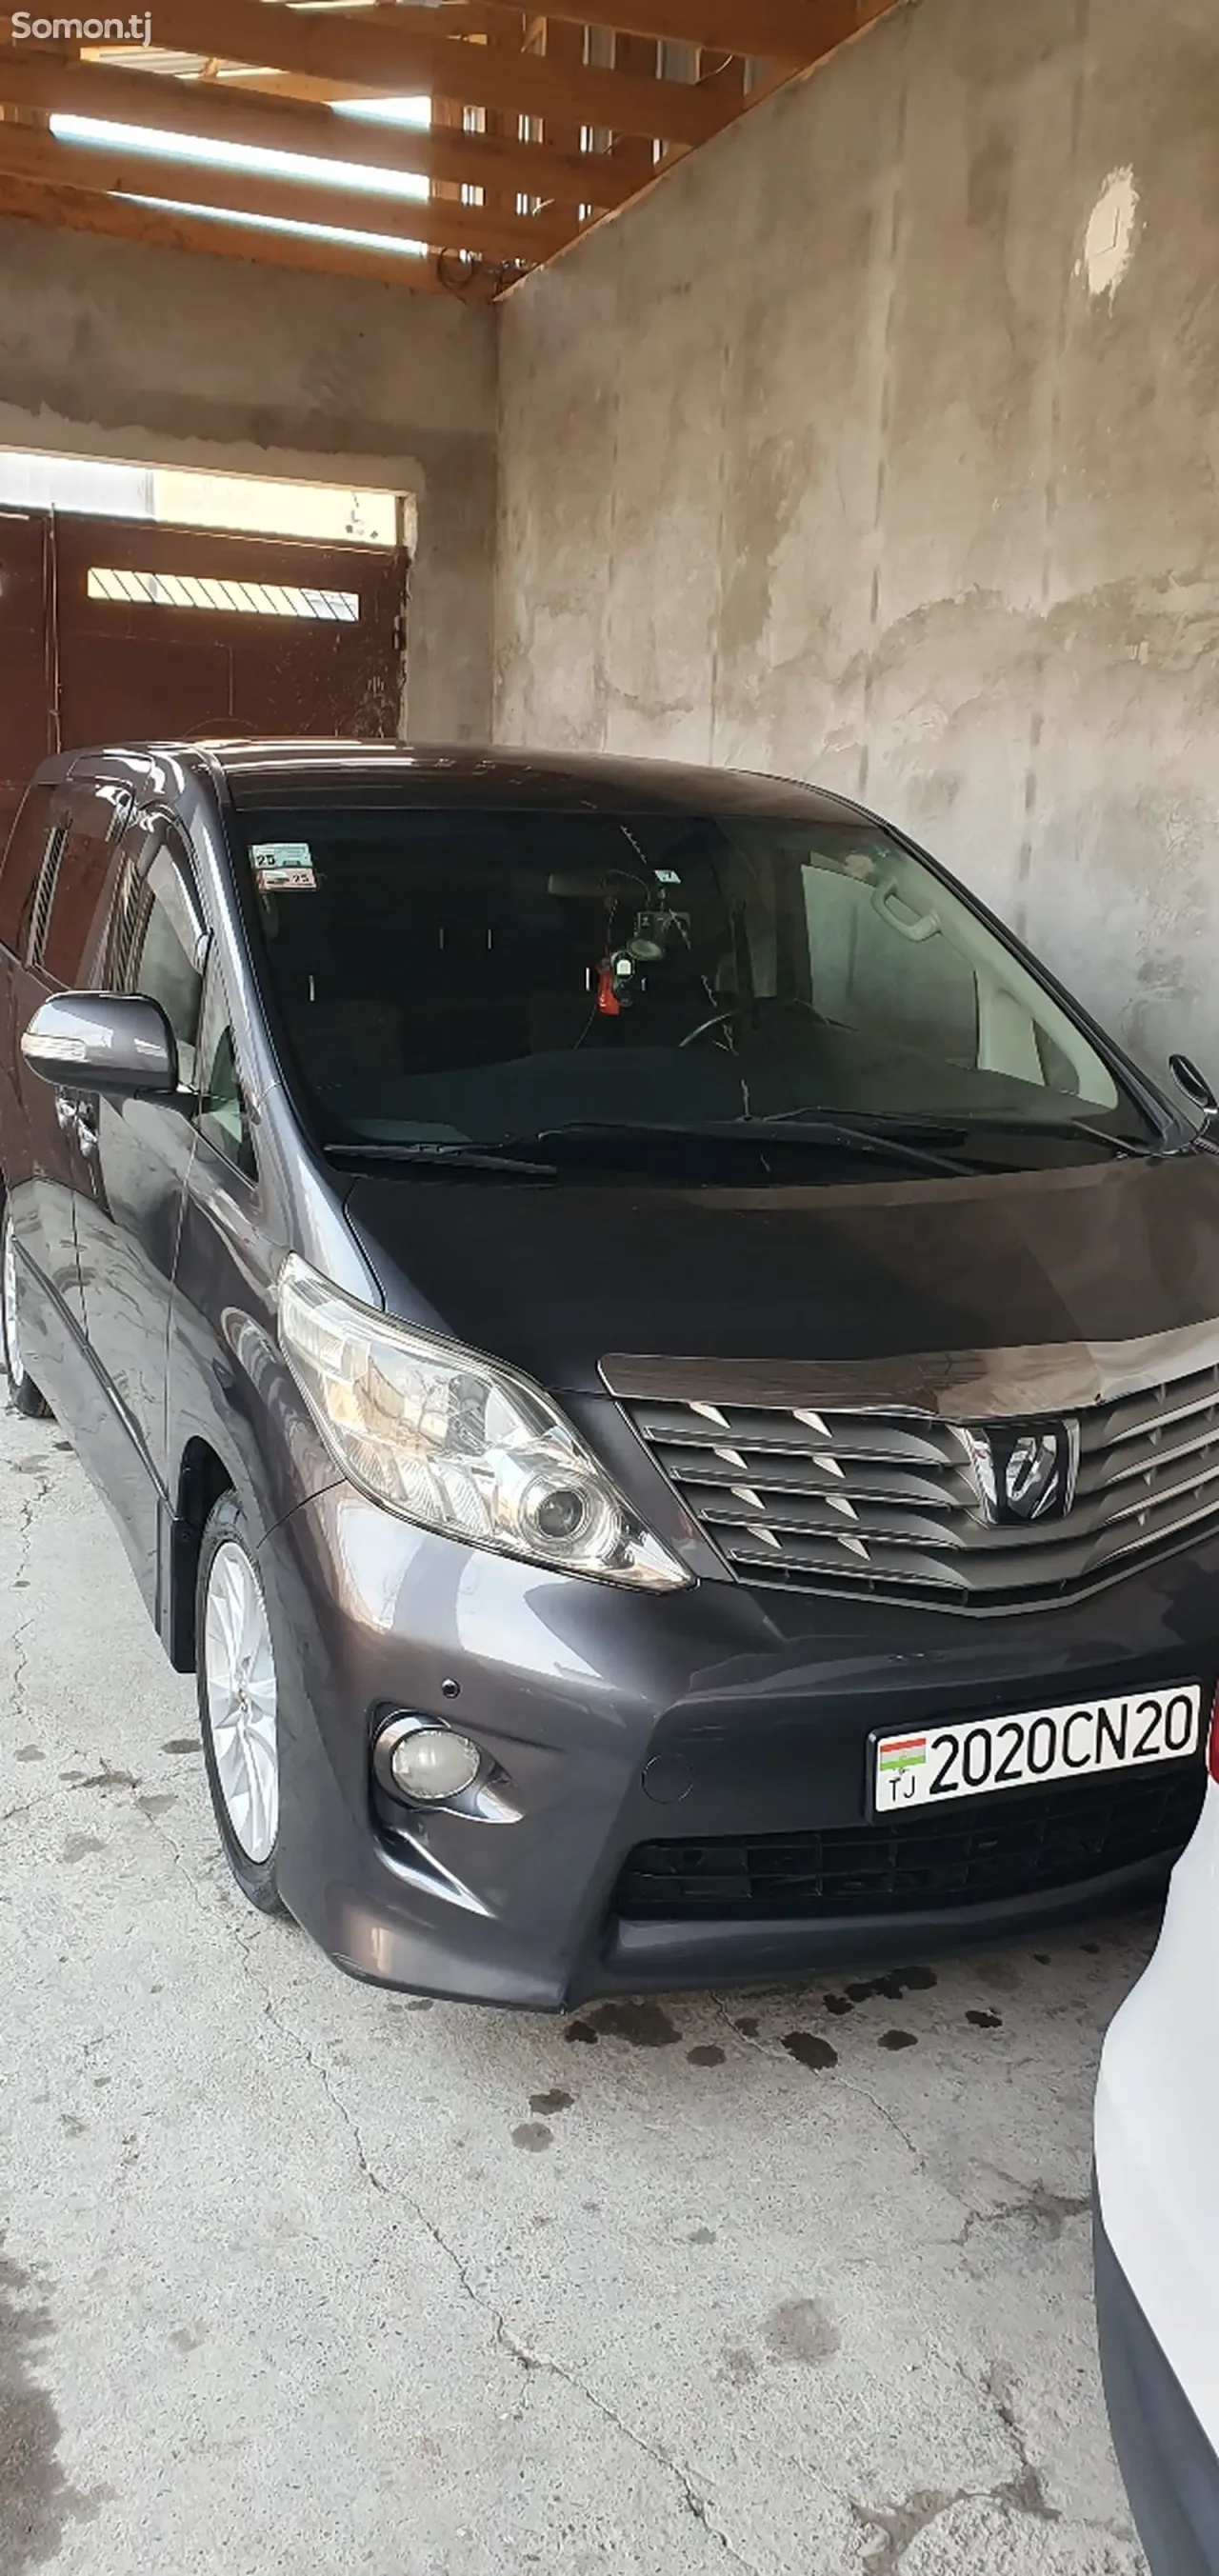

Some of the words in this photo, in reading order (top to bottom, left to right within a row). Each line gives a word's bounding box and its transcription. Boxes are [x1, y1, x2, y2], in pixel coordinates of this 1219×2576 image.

[256, 854, 275, 866] 25
[929, 1695, 1193, 1795] 2020CN20
[889, 1775, 915, 1802] TJ
